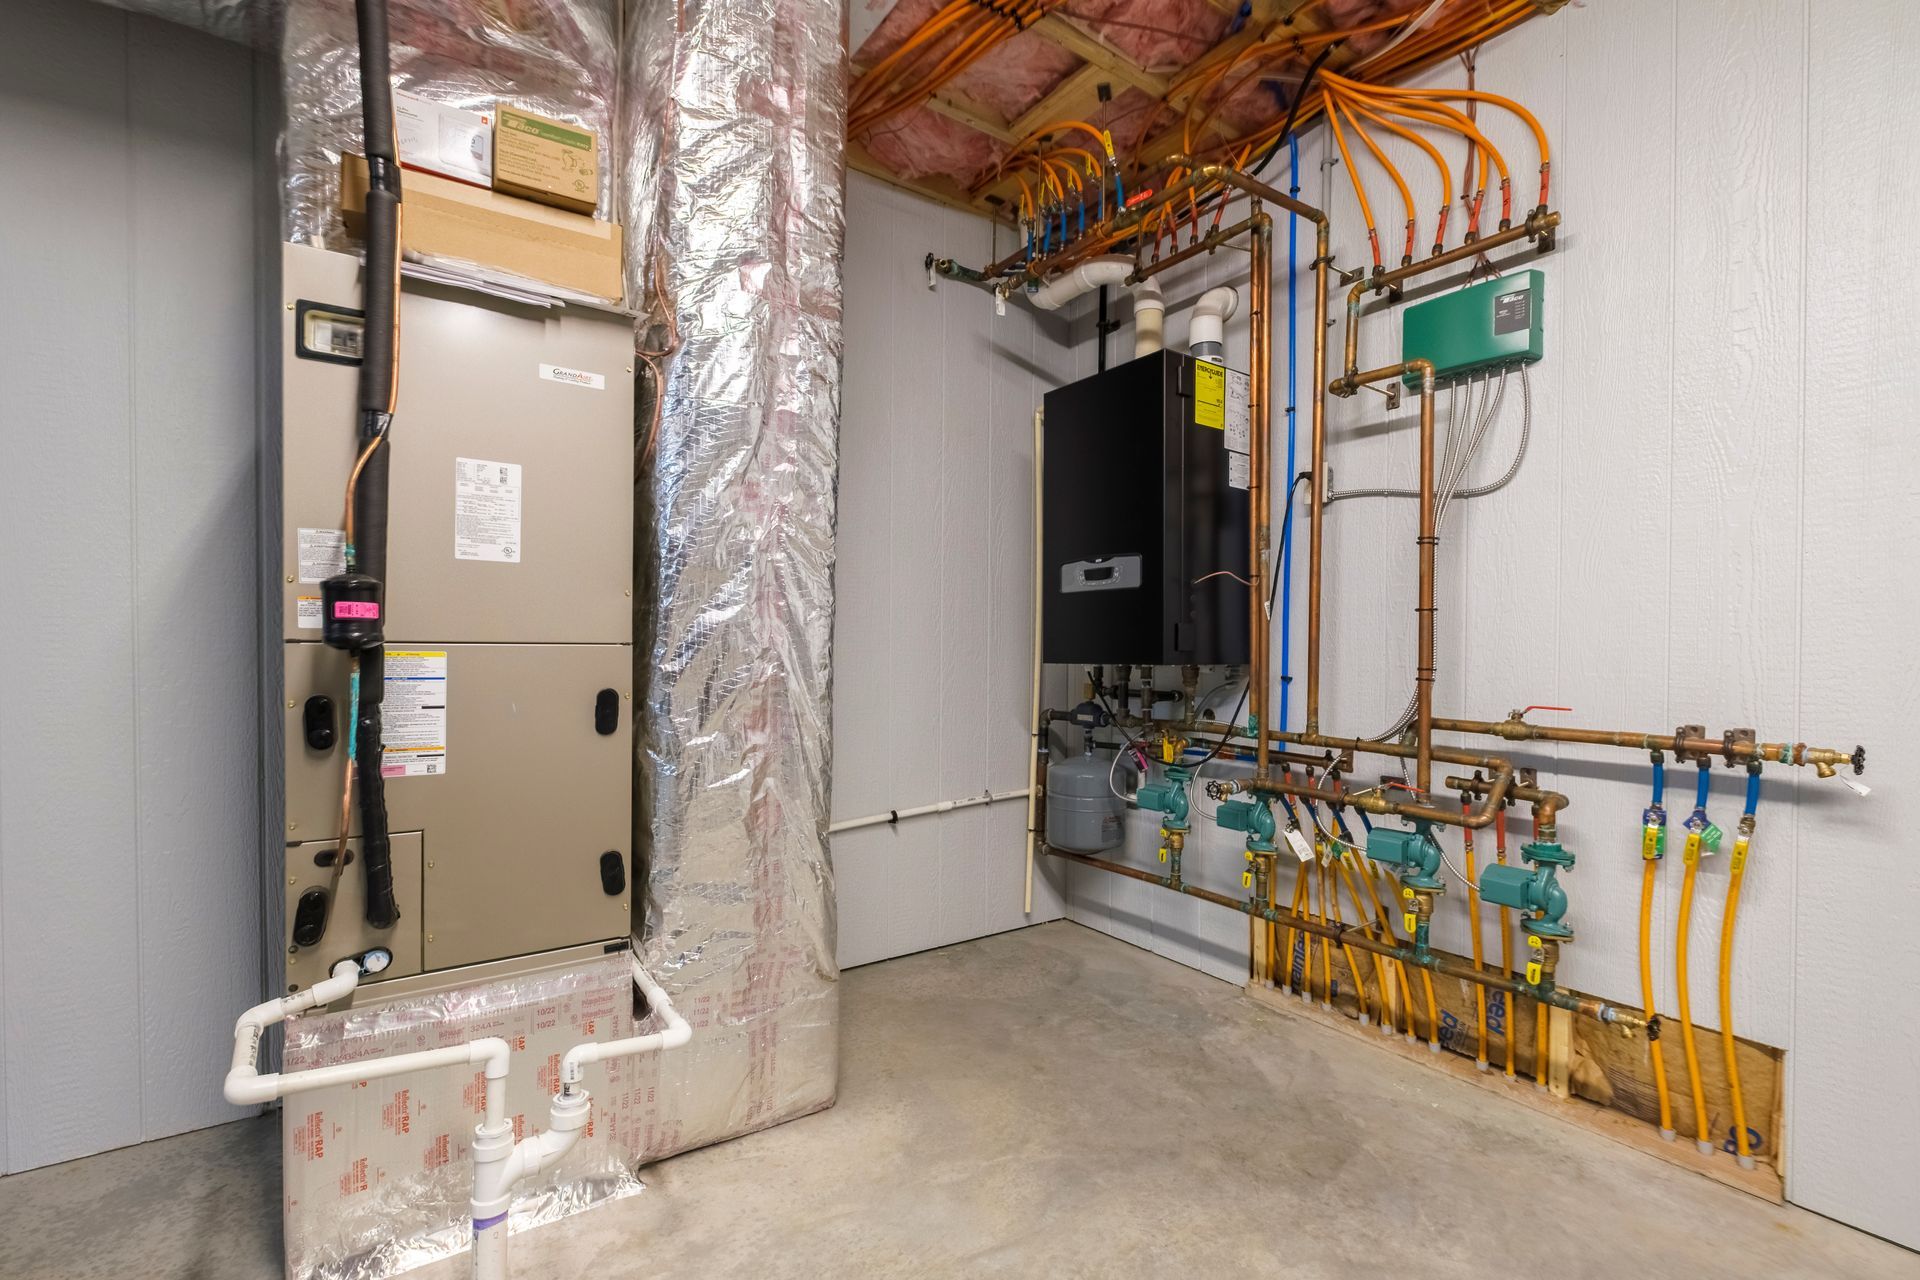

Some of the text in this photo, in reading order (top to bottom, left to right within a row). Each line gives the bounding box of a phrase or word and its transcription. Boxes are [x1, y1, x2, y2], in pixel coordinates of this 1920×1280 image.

[537, 1006, 556, 1016] 10/22
[536, 1019, 556, 1030] 10/22
[553, 1078, 561, 1095] RAP
[401, 1115, 410, 1134] RAP
[314, 1139, 324, 1159] RAP
